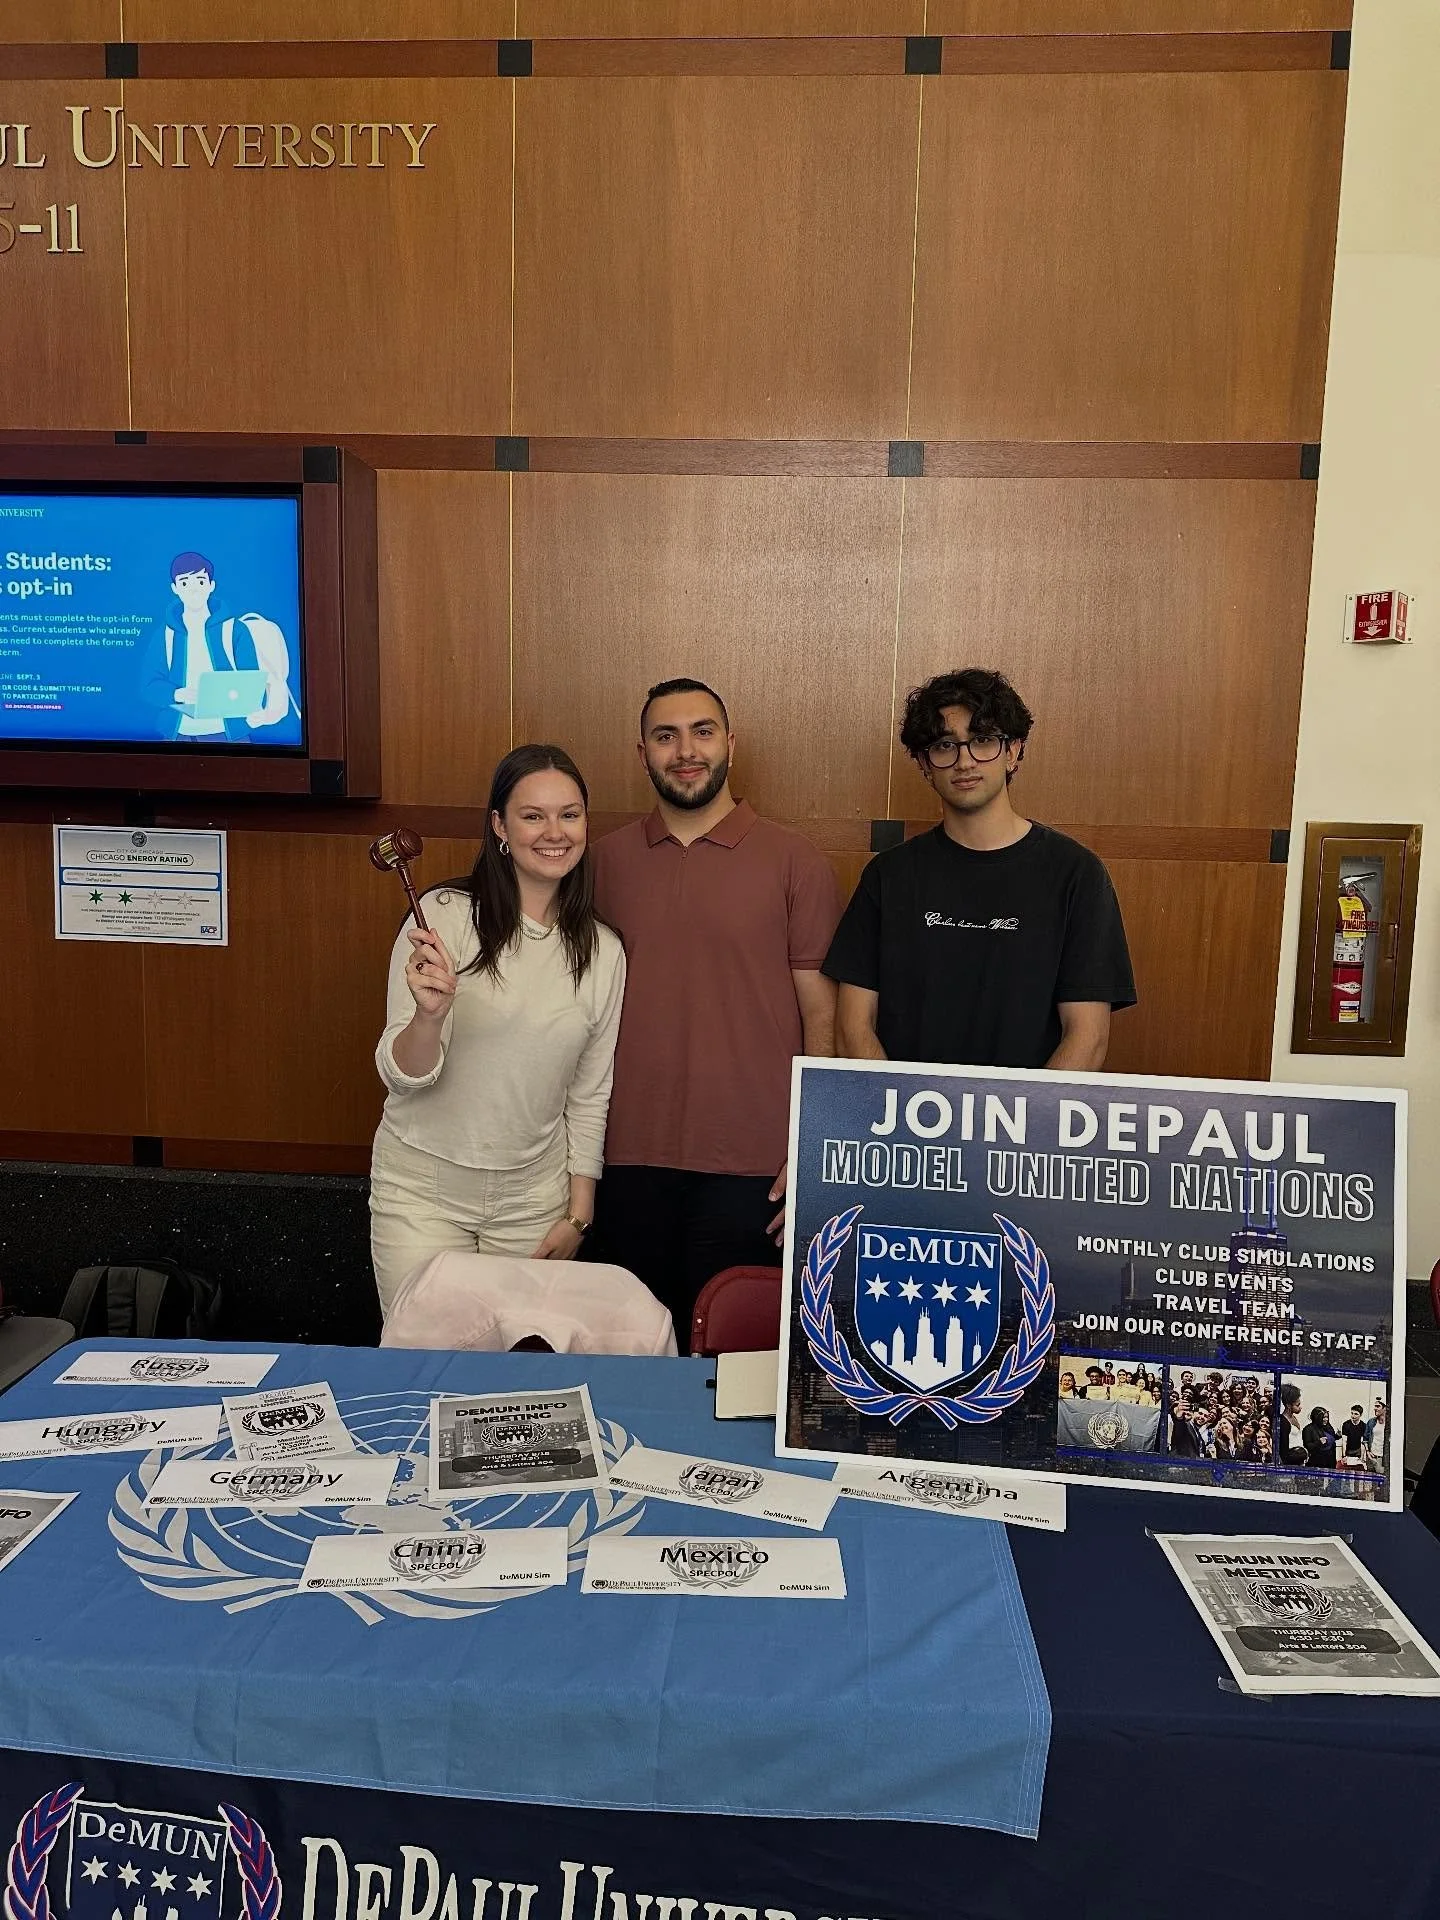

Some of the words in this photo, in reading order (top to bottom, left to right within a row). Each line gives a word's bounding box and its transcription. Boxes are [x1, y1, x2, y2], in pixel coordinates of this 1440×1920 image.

[65, 106, 437, 168] UNIVERSITY
[6, 552, 111, 571] Students:
[7, 577, 73, 599] opt-in
[1361, 593, 1389, 604] FIRE
[45, 614, 85, 625] complete
[87, 615, 101, 623] the
[103, 615, 130, 626] opt-in
[132, 615, 153, 623] form
[12, 625, 46, 633] Current
[48, 626, 87, 634] students
[109, 627, 141, 636] already
[11, 637, 31, 645] need
[44, 638, 84, 647] complete
[1351, 910, 1367, 921] FIRE
[870, 1088, 1027, 1144] JOIN
[1058, 1099, 1326, 1165] DEPAUL
[822, 1138, 968, 1193] MODEL
[986, 1150, 1150, 1206] UNITED
[1169, 1162, 1375, 1222] NATIONS
[861, 1233, 998, 1269] DeMUN
[1077, 1235, 1173, 1259] MONTHLY
[1178, 1243, 1231, 1263] CLUB
[1237, 1248, 1376, 1273] SIMULATIONS
[1155, 1268, 1209, 1288] CLUB
[1214, 1273, 1294, 1293] EVENTS
[1153, 1294, 1233, 1316] TRAVEL
[1239, 1300, 1296, 1320] TEAM
[1073, 1314, 1119, 1331] JOIN
[1124, 1317, 1166, 1336] OUR
[1170, 1321, 1304, 1347] CONFERENCE
[1309, 1332, 1377, 1351] STAFF
[131, 1359, 210, 1373] Russia
[455, 1404, 521, 1417] DEMUN
[525, 1402, 568, 1412] INFO
[473, 1412, 552, 1425] MEETING
[42, 1420, 167, 1439] Hungary
[483, 1453, 530, 1461] THURSDAY
[210, 1471, 344, 1488] Germany
[680, 1466, 761, 1491] Japan
[878, 1470, 1019, 1501] Argentina
[693, 1484, 736, 1498] SPECPOL
[923, 1491, 967, 1502] SPECPOL
[763, 1509, 793, 1522] DeMUN
[794, 1516, 809, 1524] Sim
[1003, 1512, 1034, 1523] DeMUN
[395, 1541, 483, 1559] China
[660, 1547, 770, 1565] Mexico
[409, 1562, 462, 1572] SPECPOL
[1195, 1554, 1276, 1565] DEMUN
[1277, 1556, 1331, 1567] INFO
[500, 1573, 533, 1581] DeMUN
[690, 1570, 740, 1578] SPECPOL
[1223, 1568, 1321, 1580] MEETING
[1262, 1585, 1305, 1594] DeMUN
[78, 1812, 223, 1862] DeMUN
